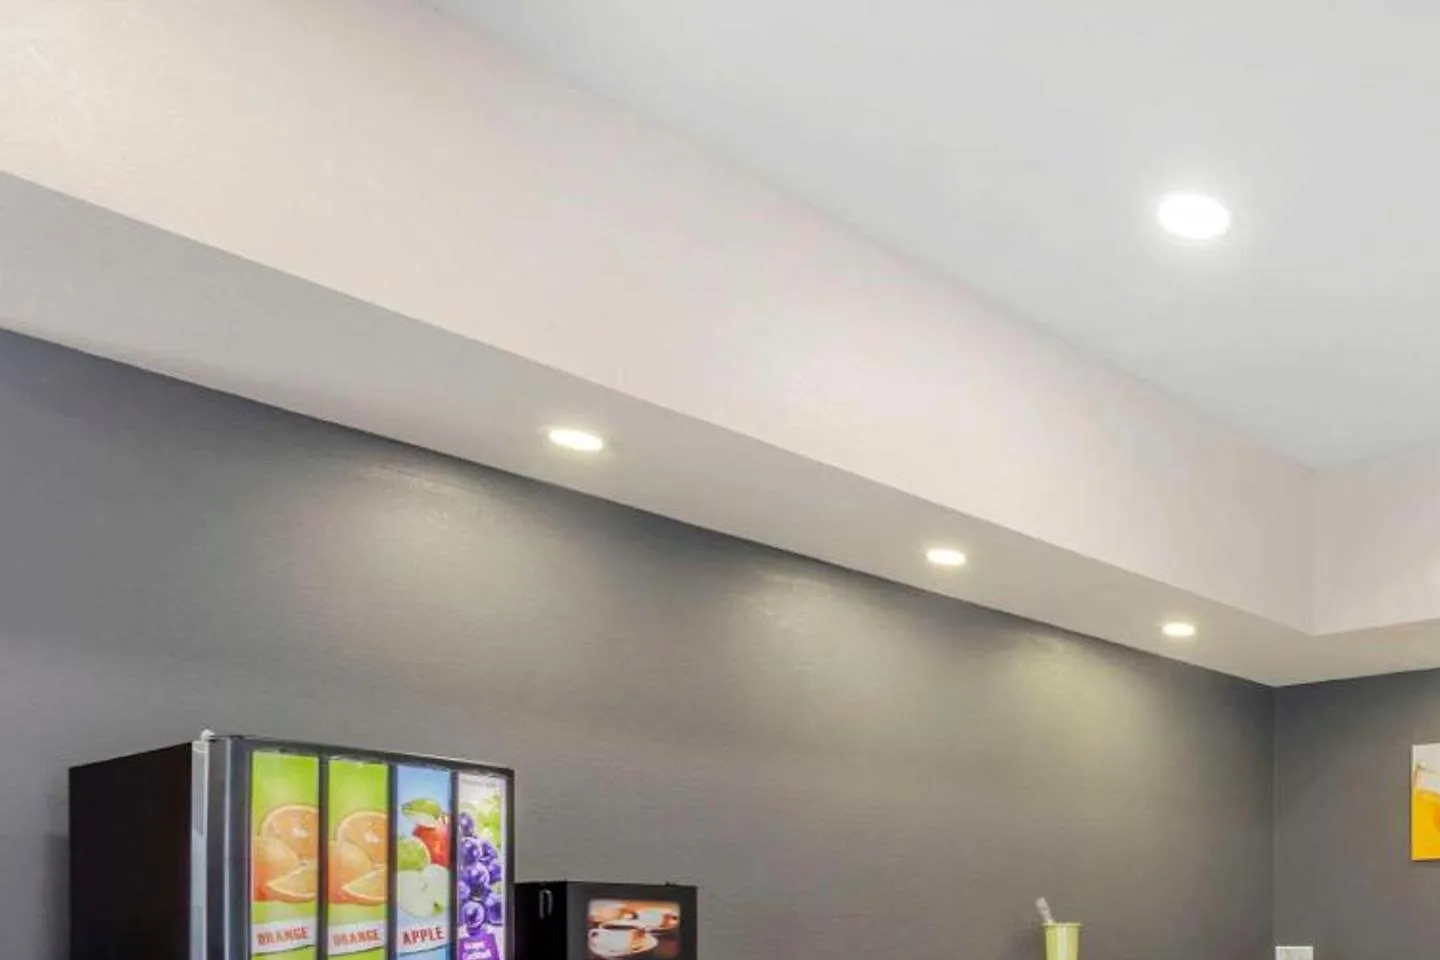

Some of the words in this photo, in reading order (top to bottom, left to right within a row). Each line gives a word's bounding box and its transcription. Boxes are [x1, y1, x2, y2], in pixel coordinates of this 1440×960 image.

[256, 926, 309, 945] ORANGE
[333, 928, 380, 946] ORANGE
[403, 926, 445, 945] APPLE
